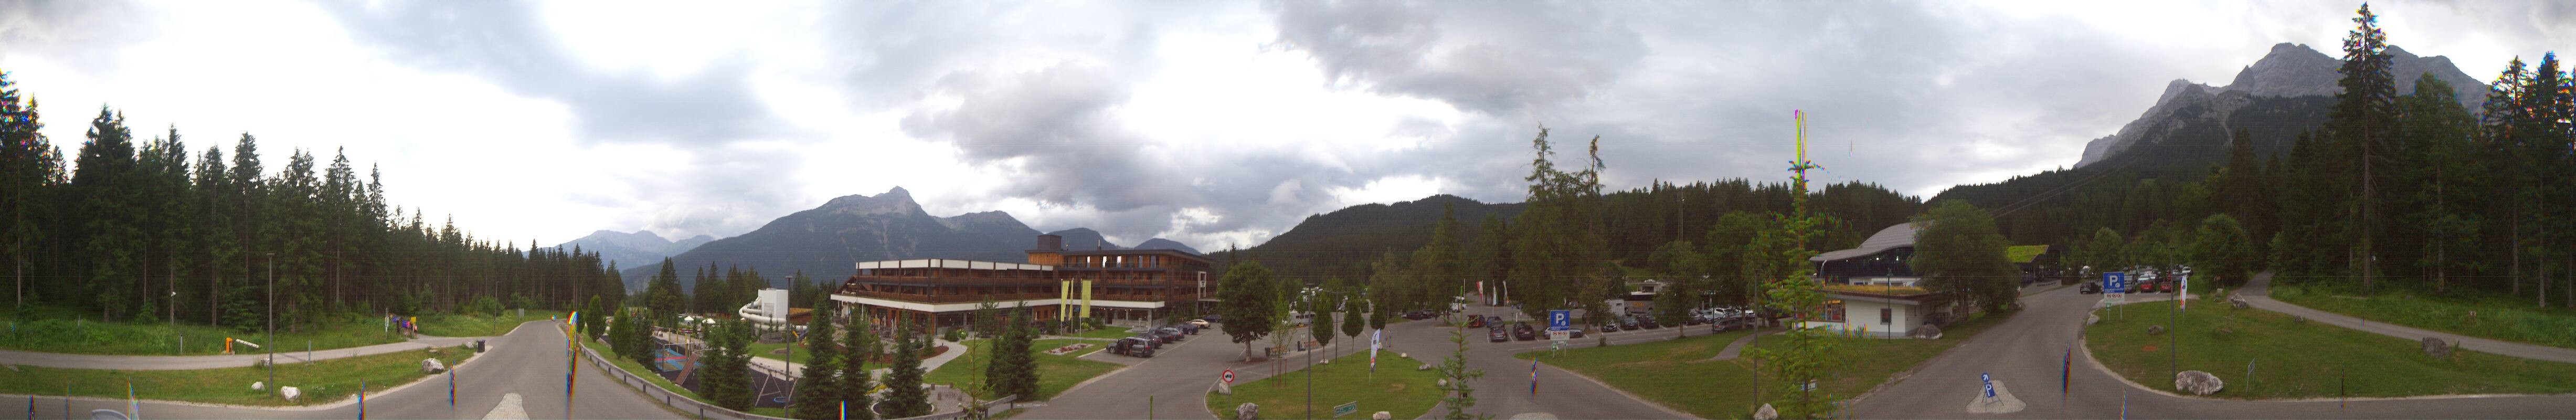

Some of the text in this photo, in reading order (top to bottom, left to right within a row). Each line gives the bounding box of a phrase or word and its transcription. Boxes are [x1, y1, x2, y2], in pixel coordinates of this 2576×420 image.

[2109, 275, 2118, 286] P
[1556, 313, 1564, 324] P
[1985, 384, 1992, 396] P
